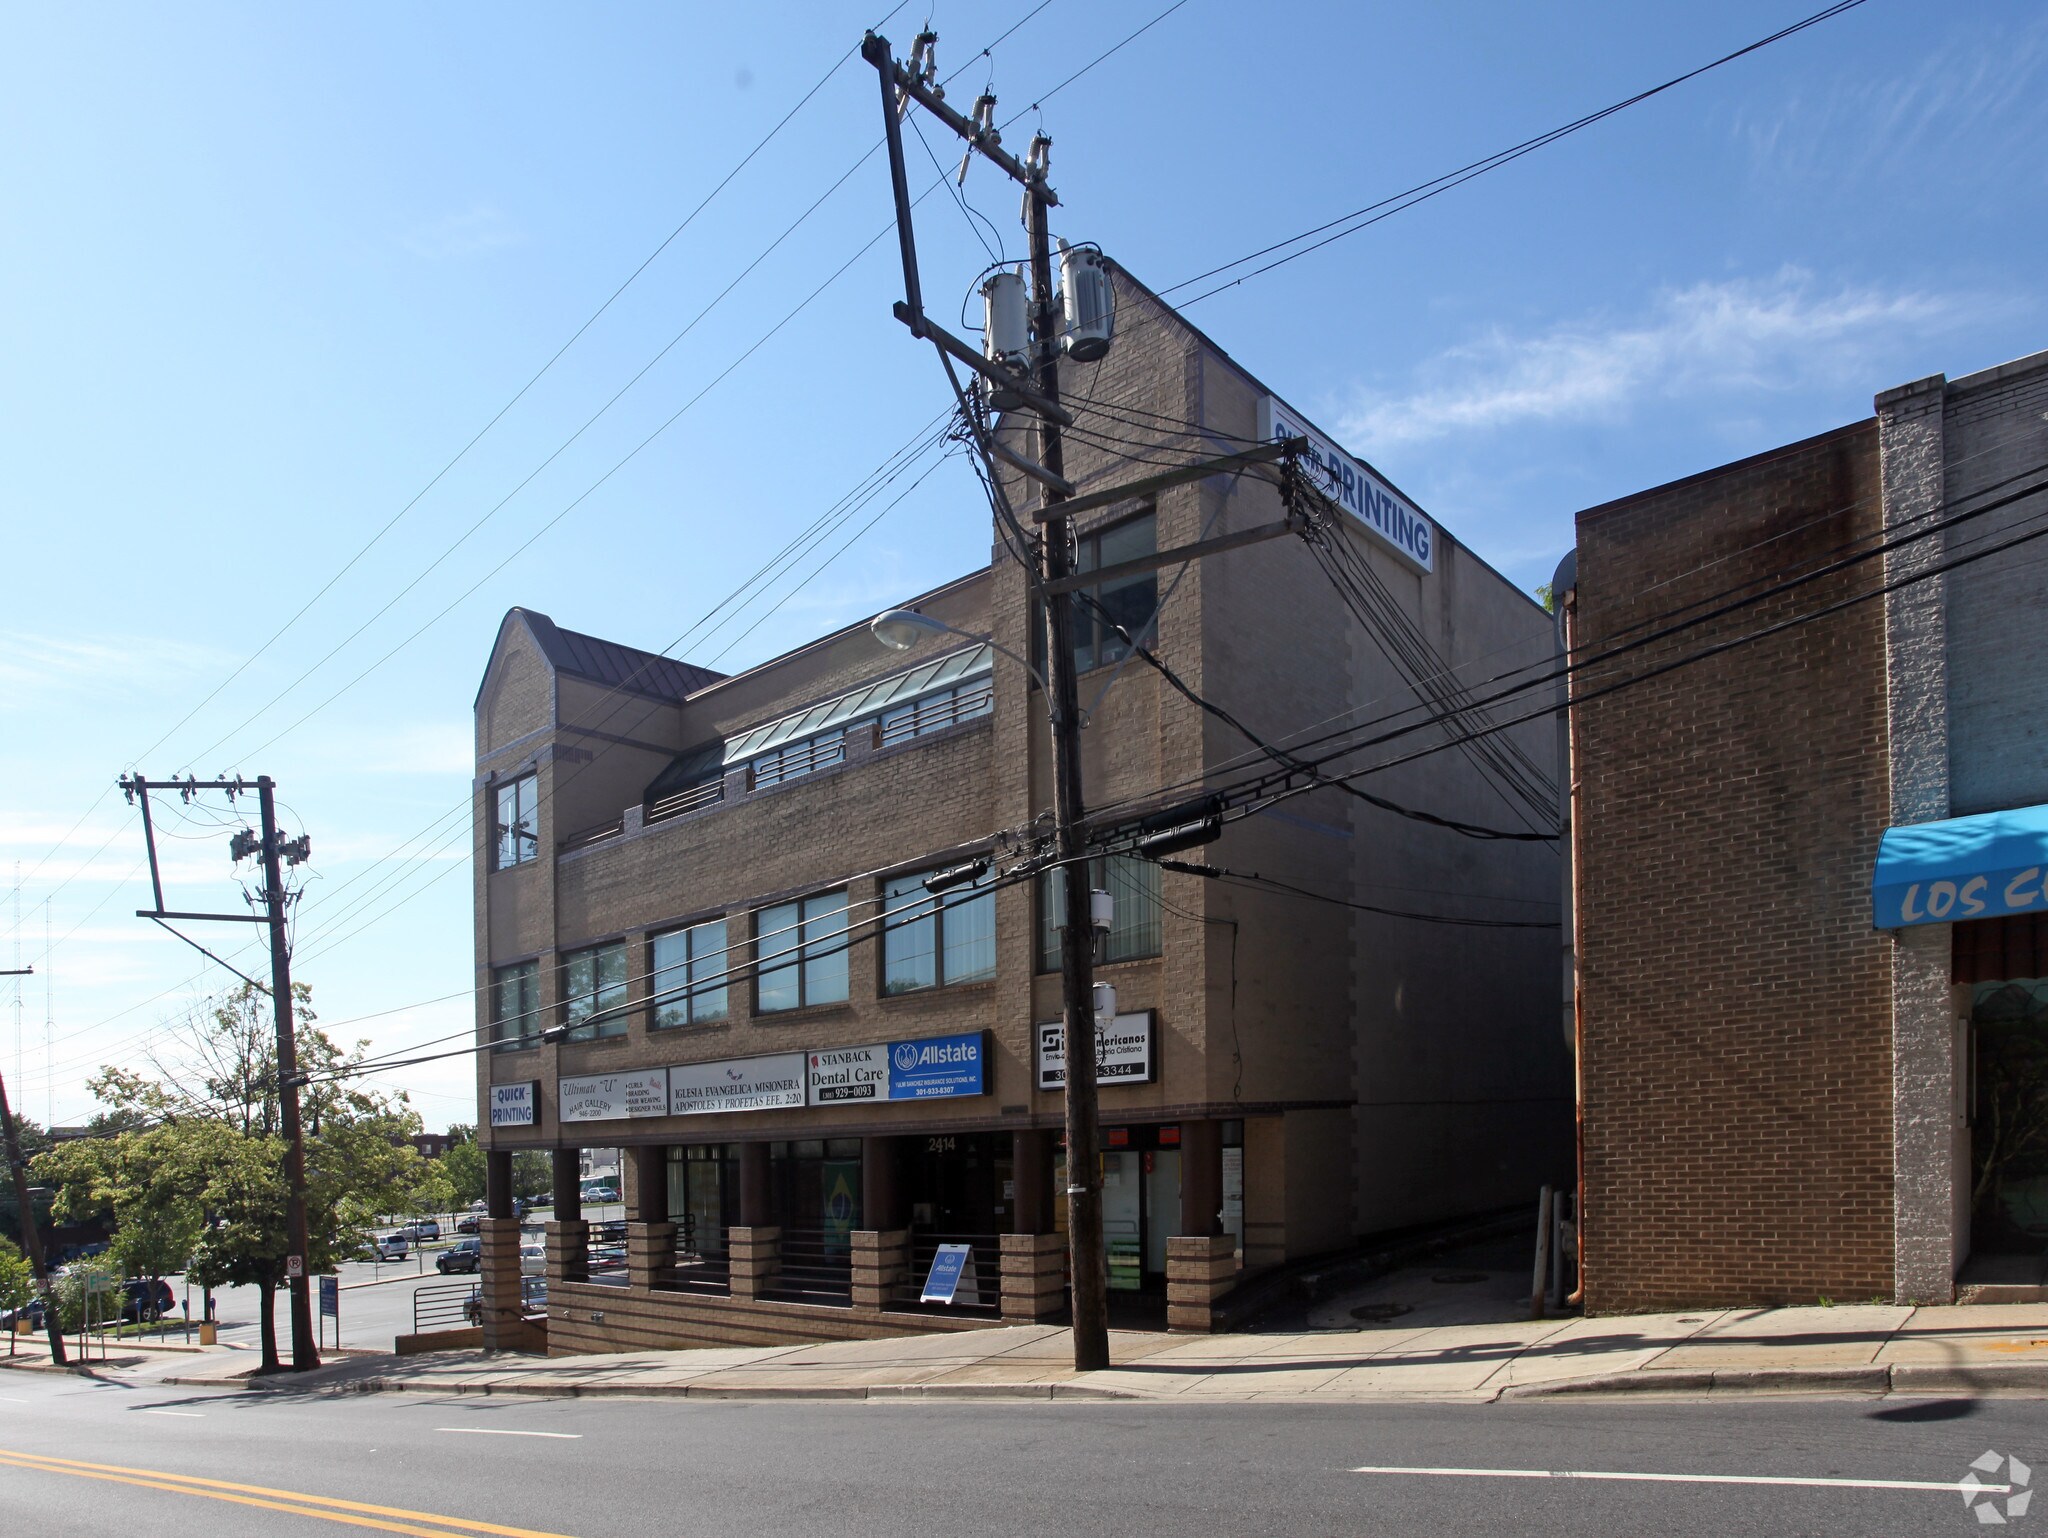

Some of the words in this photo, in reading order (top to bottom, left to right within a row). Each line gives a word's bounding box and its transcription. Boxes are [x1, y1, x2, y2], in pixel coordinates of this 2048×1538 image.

[1329, 452, 1429, 560] PRINTING
[1901, 875, 1988, 922] LOS
[2004, 867, 2048, 908] C
[918, 1042, 977, 1065] Allstate
[1116, 1045, 1142, 1054] Cristiana
[821, 1050, 872, 1066] STANBACK
[811, 1067, 850, 1086] Dental
[855, 1067, 883, 1082] Care
[906, 1079, 924, 1087] SANCHEZ
[562, 1082, 597, 1096] Ultimate
[628, 1081, 643, 1089] CURLS
[628, 1089, 650, 1097] BRAIDING
[675, 1087, 703, 1098] IGLESIA
[705, 1083, 752, 1097] EVANGELICA
[754, 1079, 800, 1093] MISIONERA
[835, 1085, 872, 1098] 929-0093
[915, 1086, 954, 1095] 301-933-8307
[497, 1087, 525, 1104] QUICK
[640, 1096, 661, 1104] WEAVING
[674, 1100, 715, 1112] APOSTOLES
[717, 1099, 723, 1109] Y
[725, 1096, 763, 1108] PROFETAS
[785, 1093, 802, 1104] 2:20
[492, 1106, 532, 1123] PRINTING
[568, 1101, 584, 1115] HAIR
[584, 1099, 612, 1112] GALLERY
[929, 1136, 956, 1152] 2414
[935, 1264, 957, 1272] Allstate
